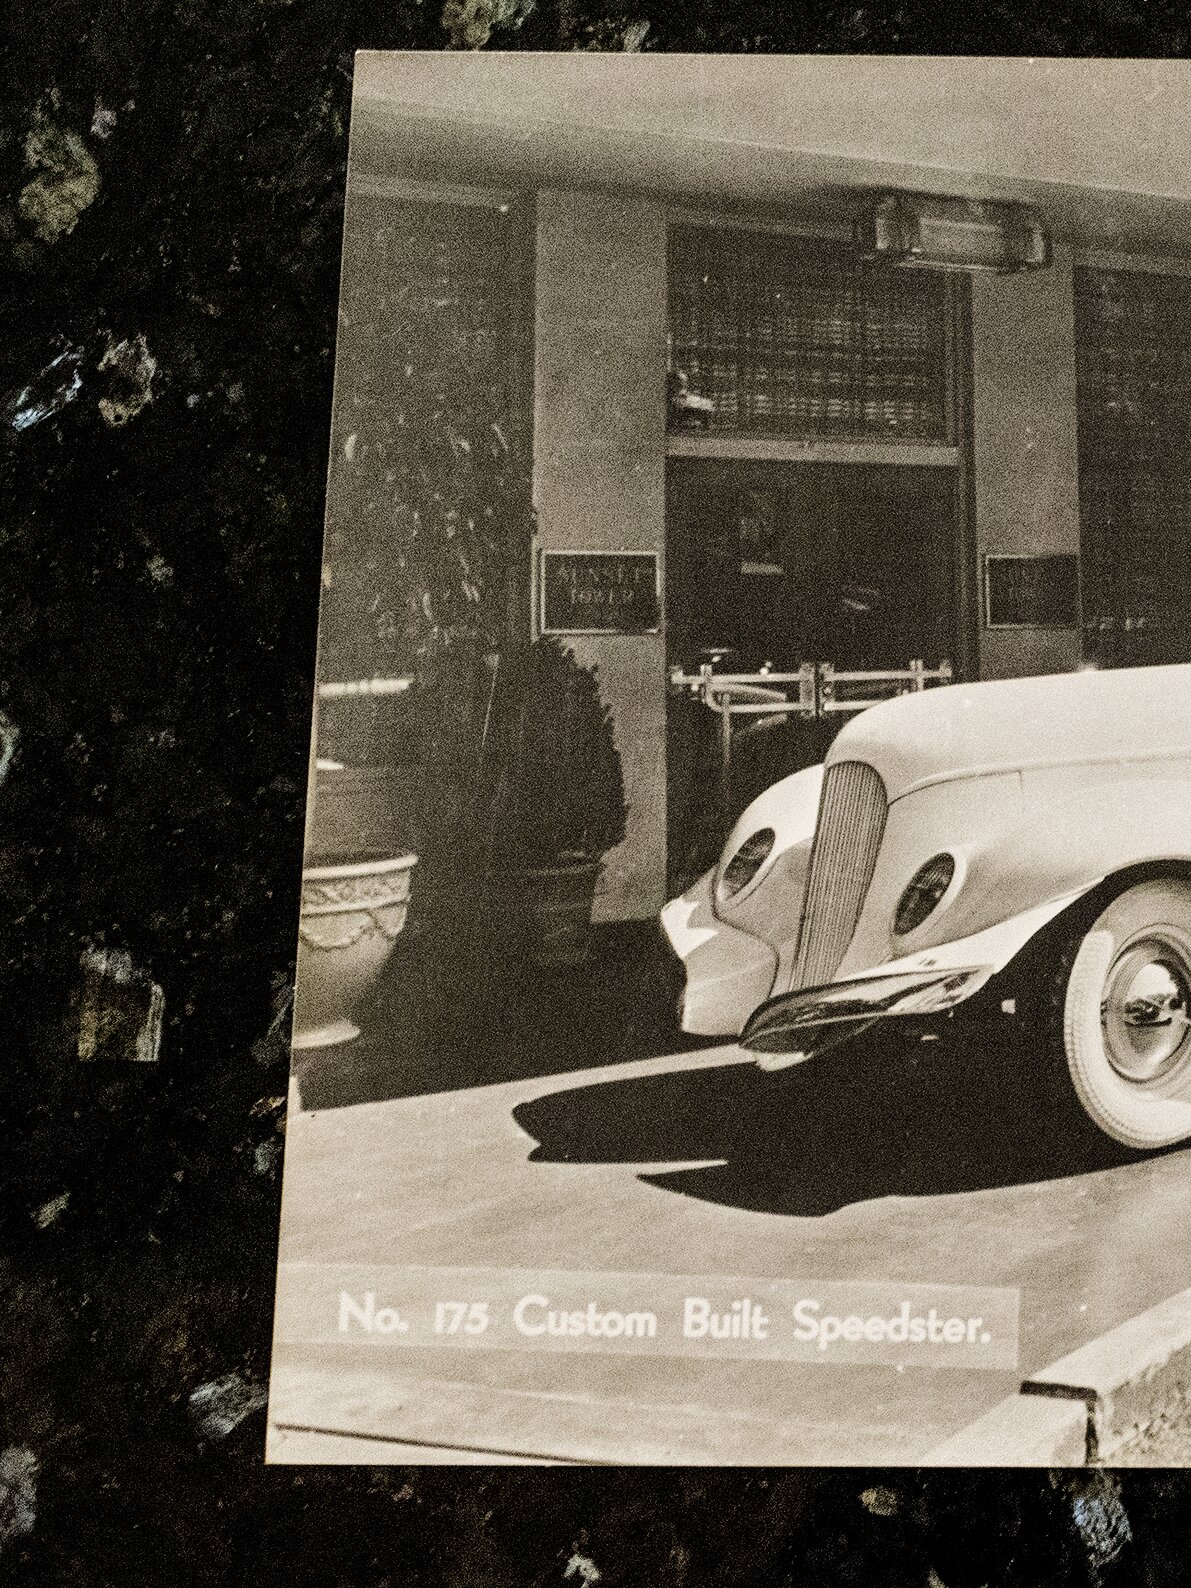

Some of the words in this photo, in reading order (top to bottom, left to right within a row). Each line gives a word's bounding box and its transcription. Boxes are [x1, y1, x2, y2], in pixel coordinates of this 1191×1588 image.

[338, 1290, 410, 1334] No.
[434, 1301, 490, 1335] 175
[512, 1294, 658, 1338] Custom
[682, 1296, 769, 1340] Built
[793, 1298, 992, 1350] Speedster.
